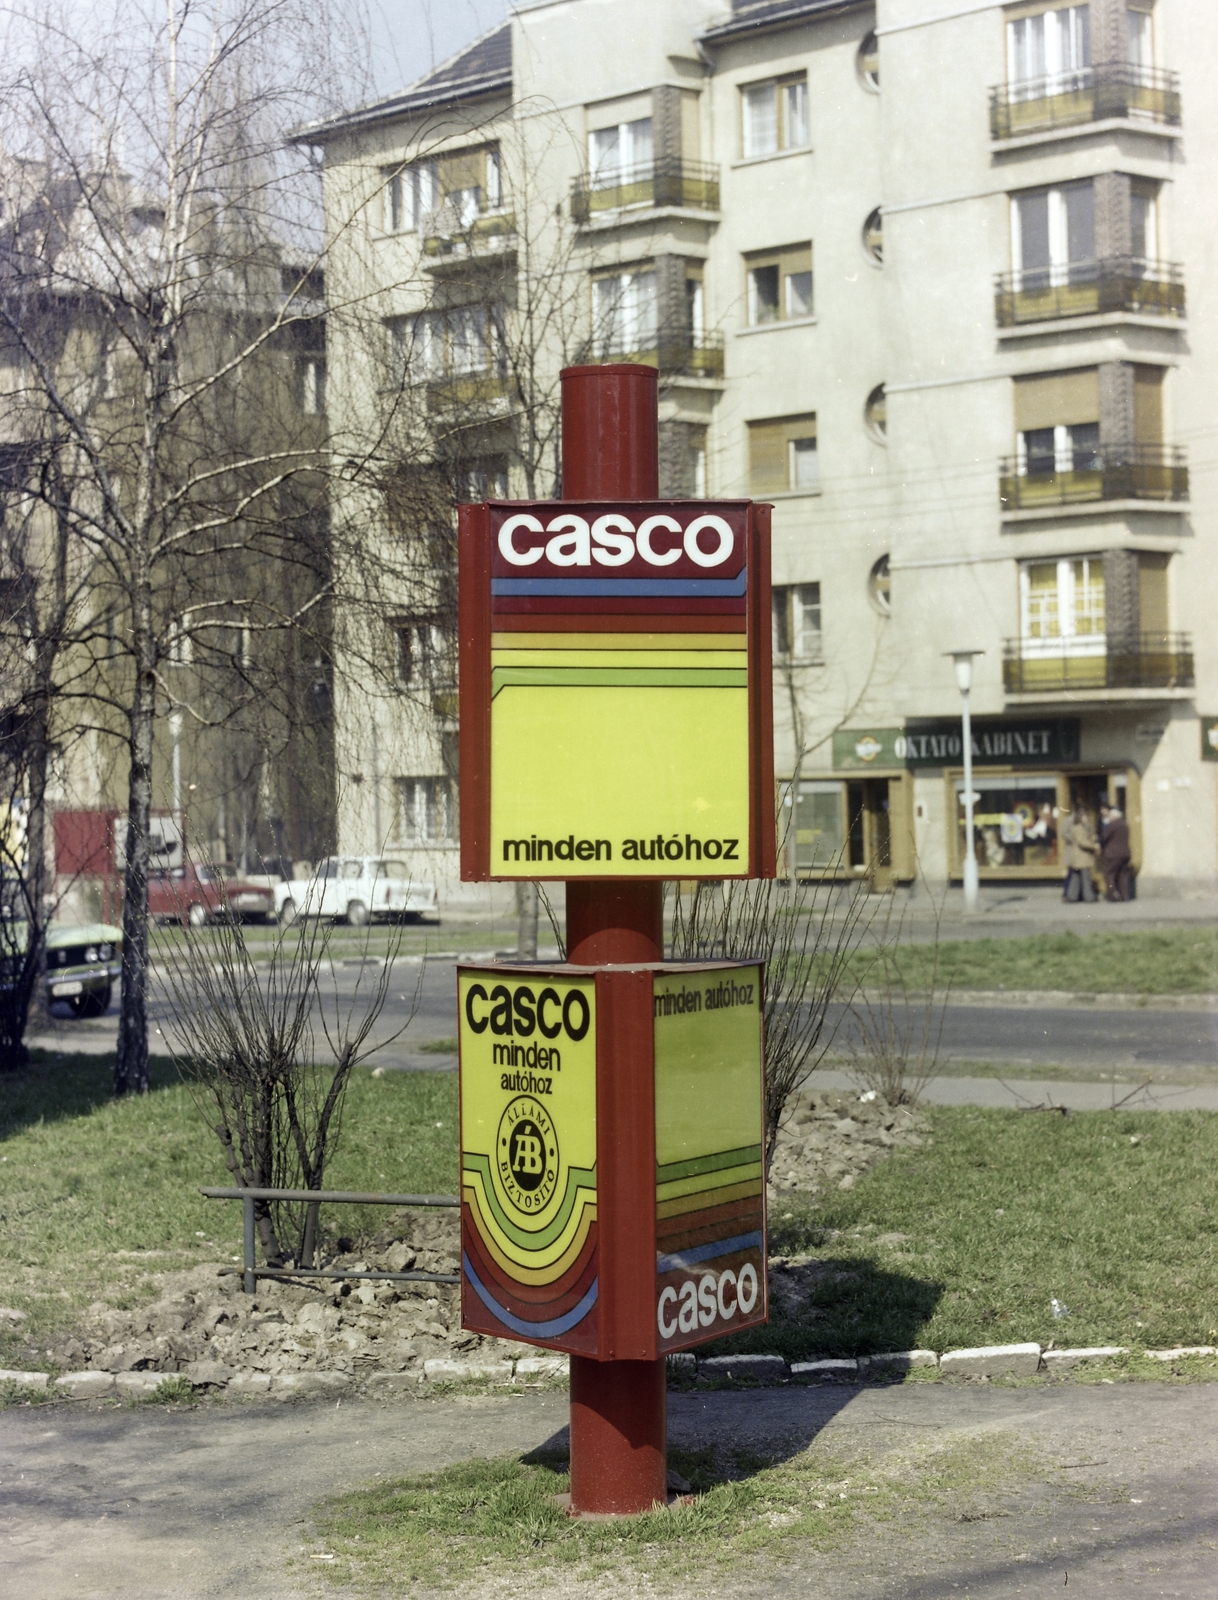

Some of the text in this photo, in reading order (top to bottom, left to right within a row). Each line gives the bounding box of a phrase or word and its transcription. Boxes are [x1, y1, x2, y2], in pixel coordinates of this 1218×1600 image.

[498, 514, 734, 567] casco
[894, 730, 961, 759] OKTATÓ
[502, 834, 739, 861] minden autóhoz
[466, 983, 590, 1042] casco
[654, 979, 754, 1017] minden autóhoz
[493, 1040, 561, 1072] minden
[500, 1071, 553, 1095] autóhoz
[507, 1103, 551, 1135] ÁLLAMI
[501, 1161, 555, 1208] BIZTOSÍTÓ
[657, 1262, 758, 1339] casco
